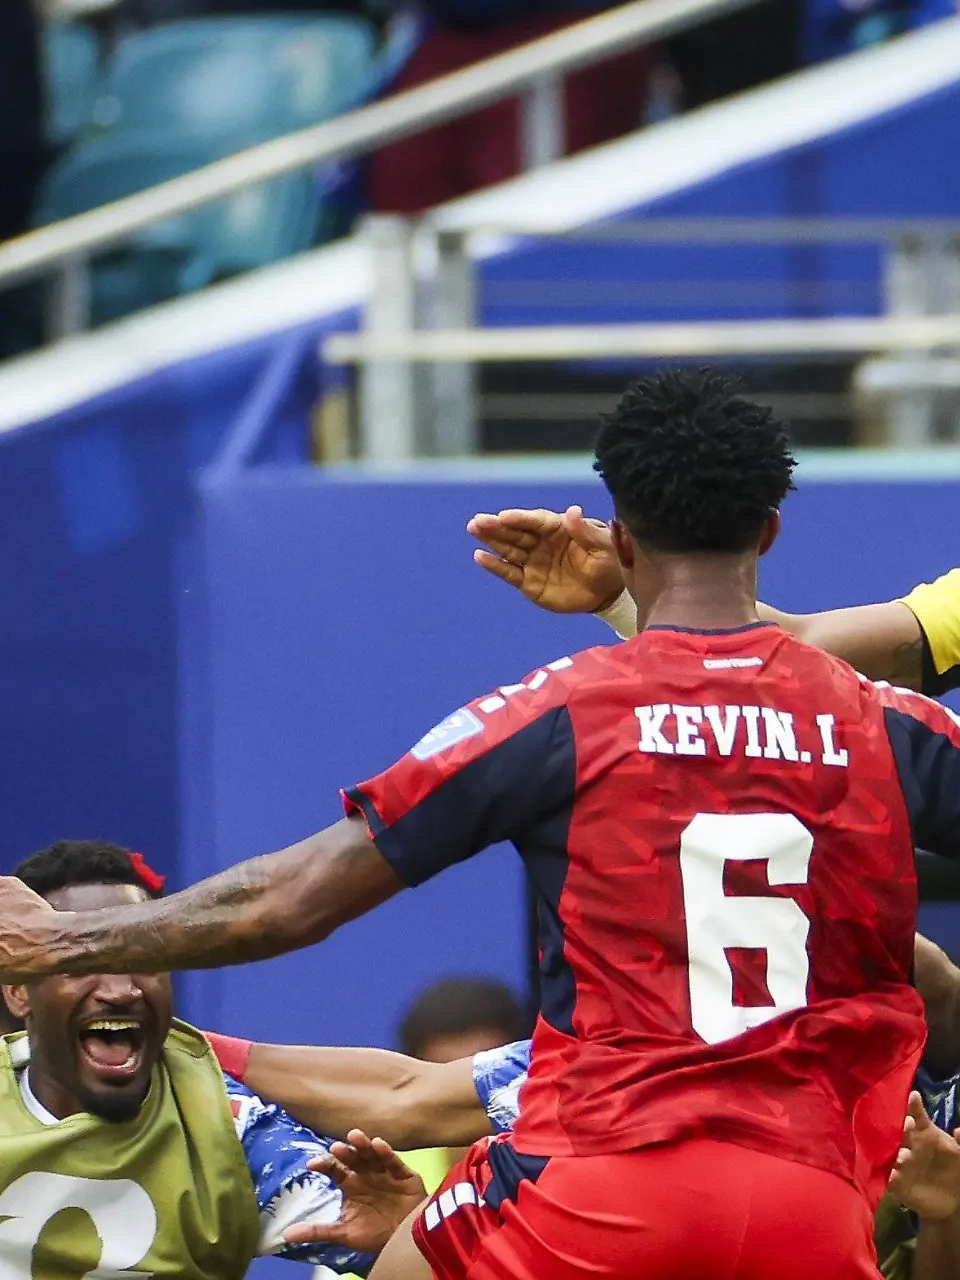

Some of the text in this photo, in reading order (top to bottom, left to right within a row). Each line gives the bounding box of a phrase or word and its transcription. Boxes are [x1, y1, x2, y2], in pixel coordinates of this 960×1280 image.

[634, 703, 849, 768] KEVIN. L
[679, 812, 815, 1045] 6
